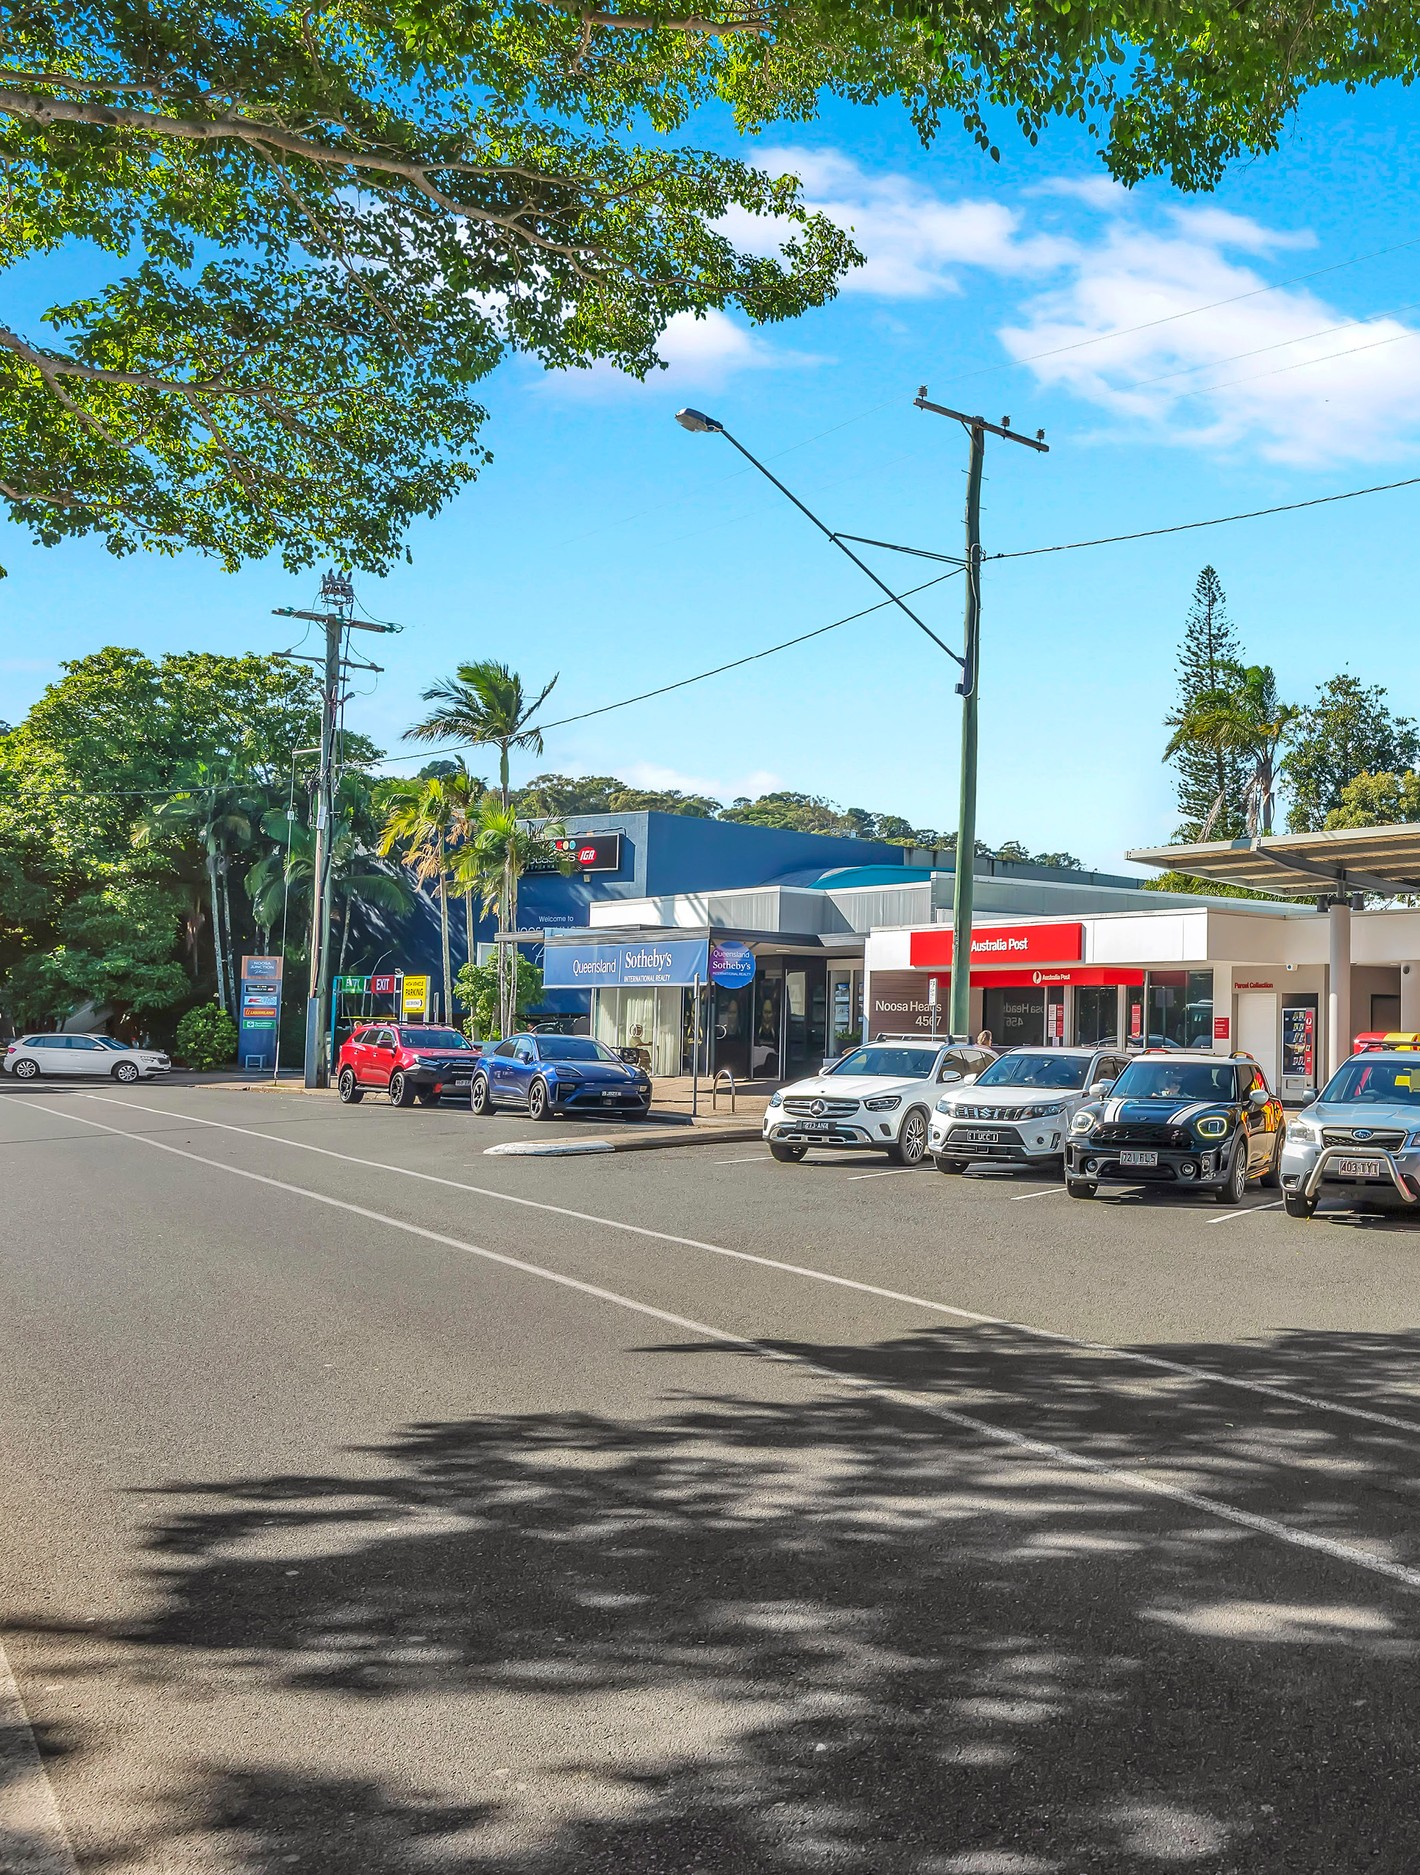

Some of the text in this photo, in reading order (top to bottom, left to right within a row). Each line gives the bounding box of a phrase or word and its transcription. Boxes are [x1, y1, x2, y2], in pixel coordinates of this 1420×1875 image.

[580, 850, 595, 860] IGA
[971, 938, 1028, 952] Australia Post
[713, 950, 750, 958] Queensland
[625, 949, 672, 971] Sotheby's
[573, 959, 616, 976] Queensland
[713, 961, 750, 971] Sotheby's
[376, 979, 390, 990] EXIT
[875, 1000, 908, 1011] Noosa
